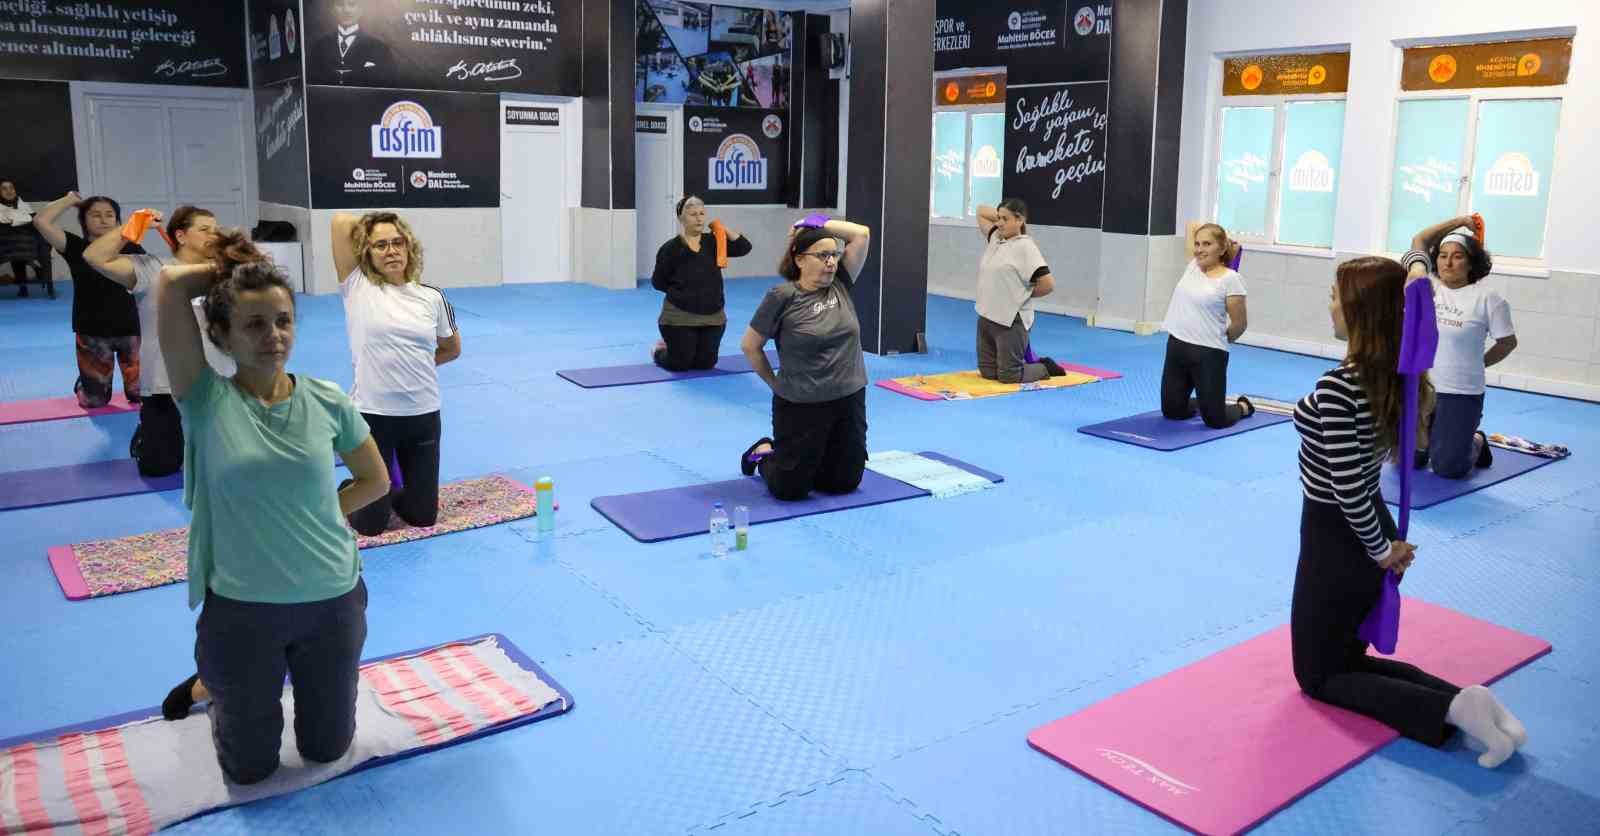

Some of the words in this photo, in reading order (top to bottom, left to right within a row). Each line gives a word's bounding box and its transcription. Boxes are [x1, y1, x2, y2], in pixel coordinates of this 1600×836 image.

[56, 3, 120, 20] sağlıklı
[121, 8, 178, 27] yetişip
[404, 9, 443, 25] çevik
[446, 15, 463, 25] ve
[464, 15, 494, 30] aynı
[496, 19, 558, 33] zamanda
[19, 19, 129, 39] ulusumuzun
[130, 27, 197, 47] geleceği
[935, 18, 954, 34] SPOR
[956, 21, 965, 33] ve
[1029, 29, 1056, 41] BÖCEK
[1095, 19, 1111, 35] DA
[507, 110, 539, 121] SOYUNMA
[539, 111, 559, 121] ODASI
[1013, 89, 1074, 132] Sağlıklı
[379, 120, 435, 156] asfim
[714, 151, 762, 188] asfim
[373, 180, 396, 189] BÖCEK
[428, 179, 443, 189] DAL
